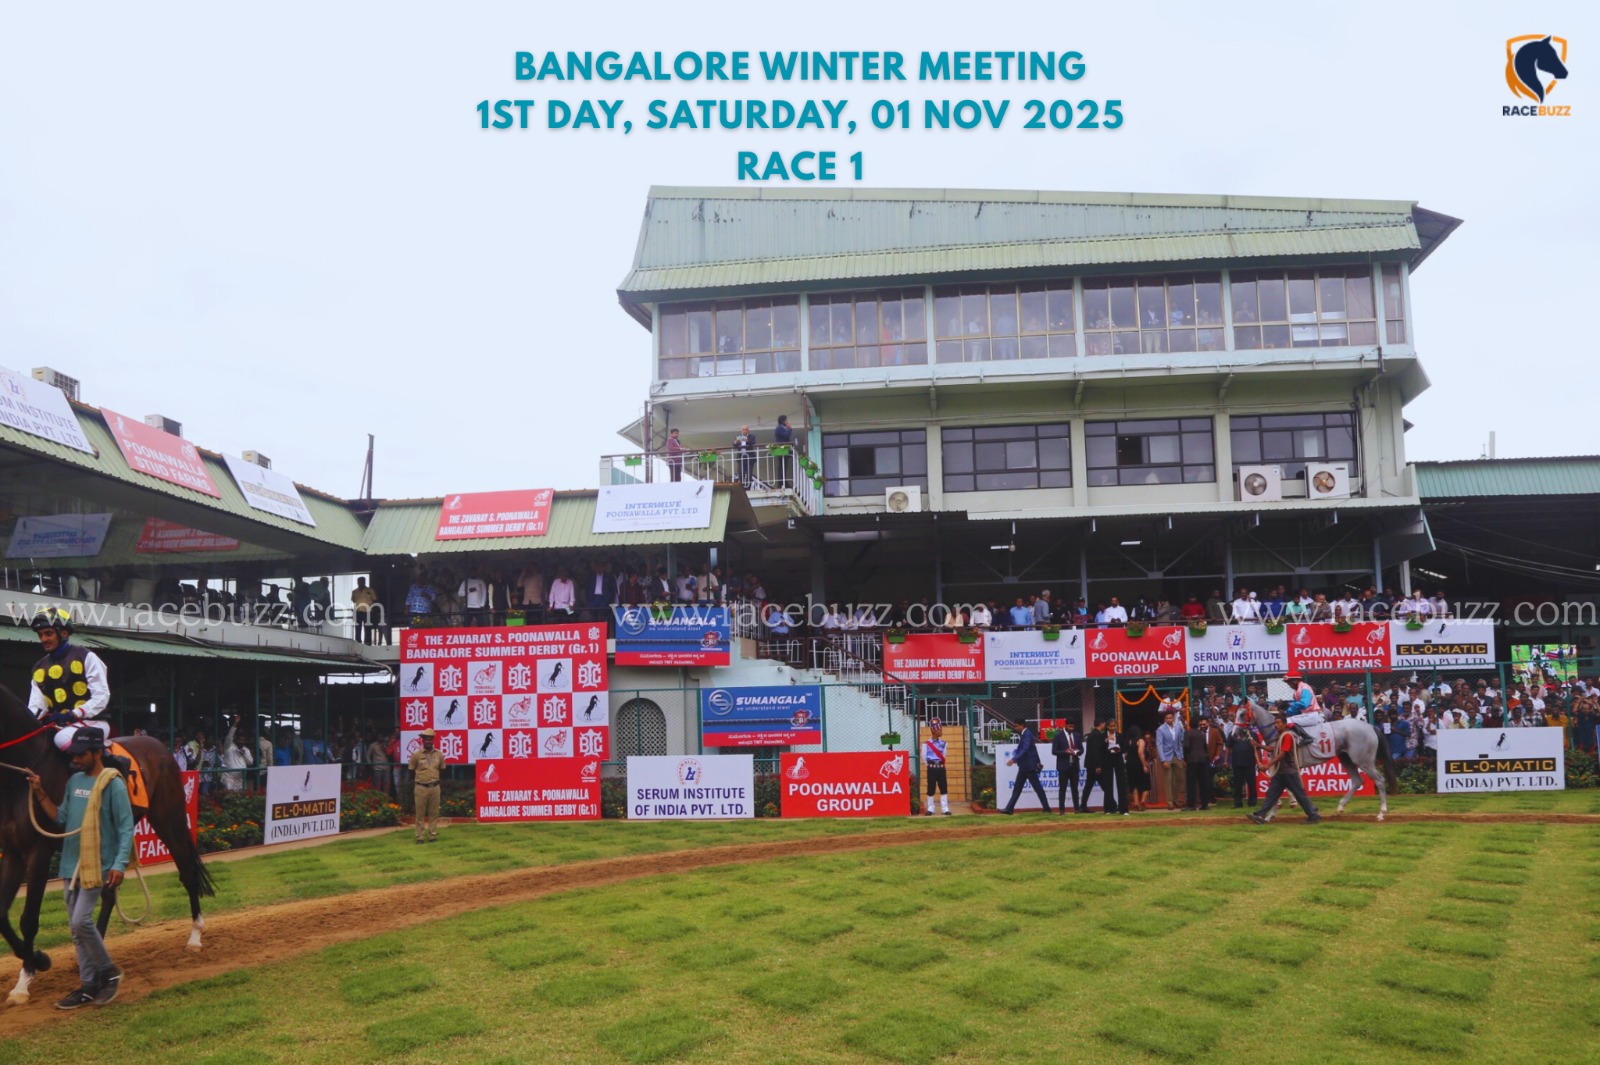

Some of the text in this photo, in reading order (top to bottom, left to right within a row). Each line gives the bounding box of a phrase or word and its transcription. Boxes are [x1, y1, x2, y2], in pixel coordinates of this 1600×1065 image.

[16, 400, 78, 432] INSTITUTE
[123, 439, 208, 478] POONAWALLA
[134, 456, 211, 492] STUD FARMS
[449, 514, 461, 524] THE
[461, 513, 489, 523] ZAVARAY
[496, 511, 539, 521] POONAWALLA
[606, 509, 661, 518] POONAWALLA
[439, 525, 476, 536] BANGALORE
[476, 524, 505, 534] SUMMER
[505, 522, 526, 532] DERBY
[648, 617, 717, 626] SUMANGALA
[424, 635, 443, 645] THE
[446, 634, 492, 645] ZAVARAY
[495, 633, 505, 643] S.
[508, 630, 580, 643] POONAWALLA
[406, 643, 600, 659] BANGALORE SUMMER DERBY (Gr.1)
[1193, 650, 1282, 662] SERUM INSTITUTE
[1294, 646, 1386, 659] POONAWALLA
[1399, 644, 1487, 655] EL-O-MATIC
[893, 659, 904, 668] THE
[905, 658, 929, 668] ZAVARAY
[937, 658, 976, 668] POONAWALLA
[1091, 650, 1182, 663] POONAWALLA
[1396, 658, 1436, 667] (INDIA)
[1114, 663, 1160, 675] GROUP
[1192, 664, 1205, 673] OF
[1208, 664, 1235, 673] INDIA
[1297, 658, 1383, 671] STUD FARMS
[887, 671, 920, 680] BANGALORE
[921, 670, 946, 680] SUMMER
[947, 670, 965, 680] DERBY
[735, 695, 807, 706] SUMANGALA
[1318, 739, 1332, 753] 11
[1449, 760, 1554, 773] EL-O-MATIC
[789, 781, 903, 796] POONAWALLA
[1445, 776, 1558, 790] (INDIA) PVT. LTD.
[487, 788, 589, 802] THE ZAVARAY S. POONAWALLA
[637, 787, 745, 800] SERUM INSTITUTE
[274, 801, 336, 819] EL-O-MATIC
[480, 806, 520, 818] BANGALORE
[522, 805, 552, 817] SUMMER
[554, 804, 577, 816] DERBY
[634, 803, 747, 816] OF INDIA PVT. LTD.
[816, 798, 875, 812] GROUP
[271, 818, 336, 840] (INDIA) PVT. LTD.
[139, 838, 170, 859] FAR
